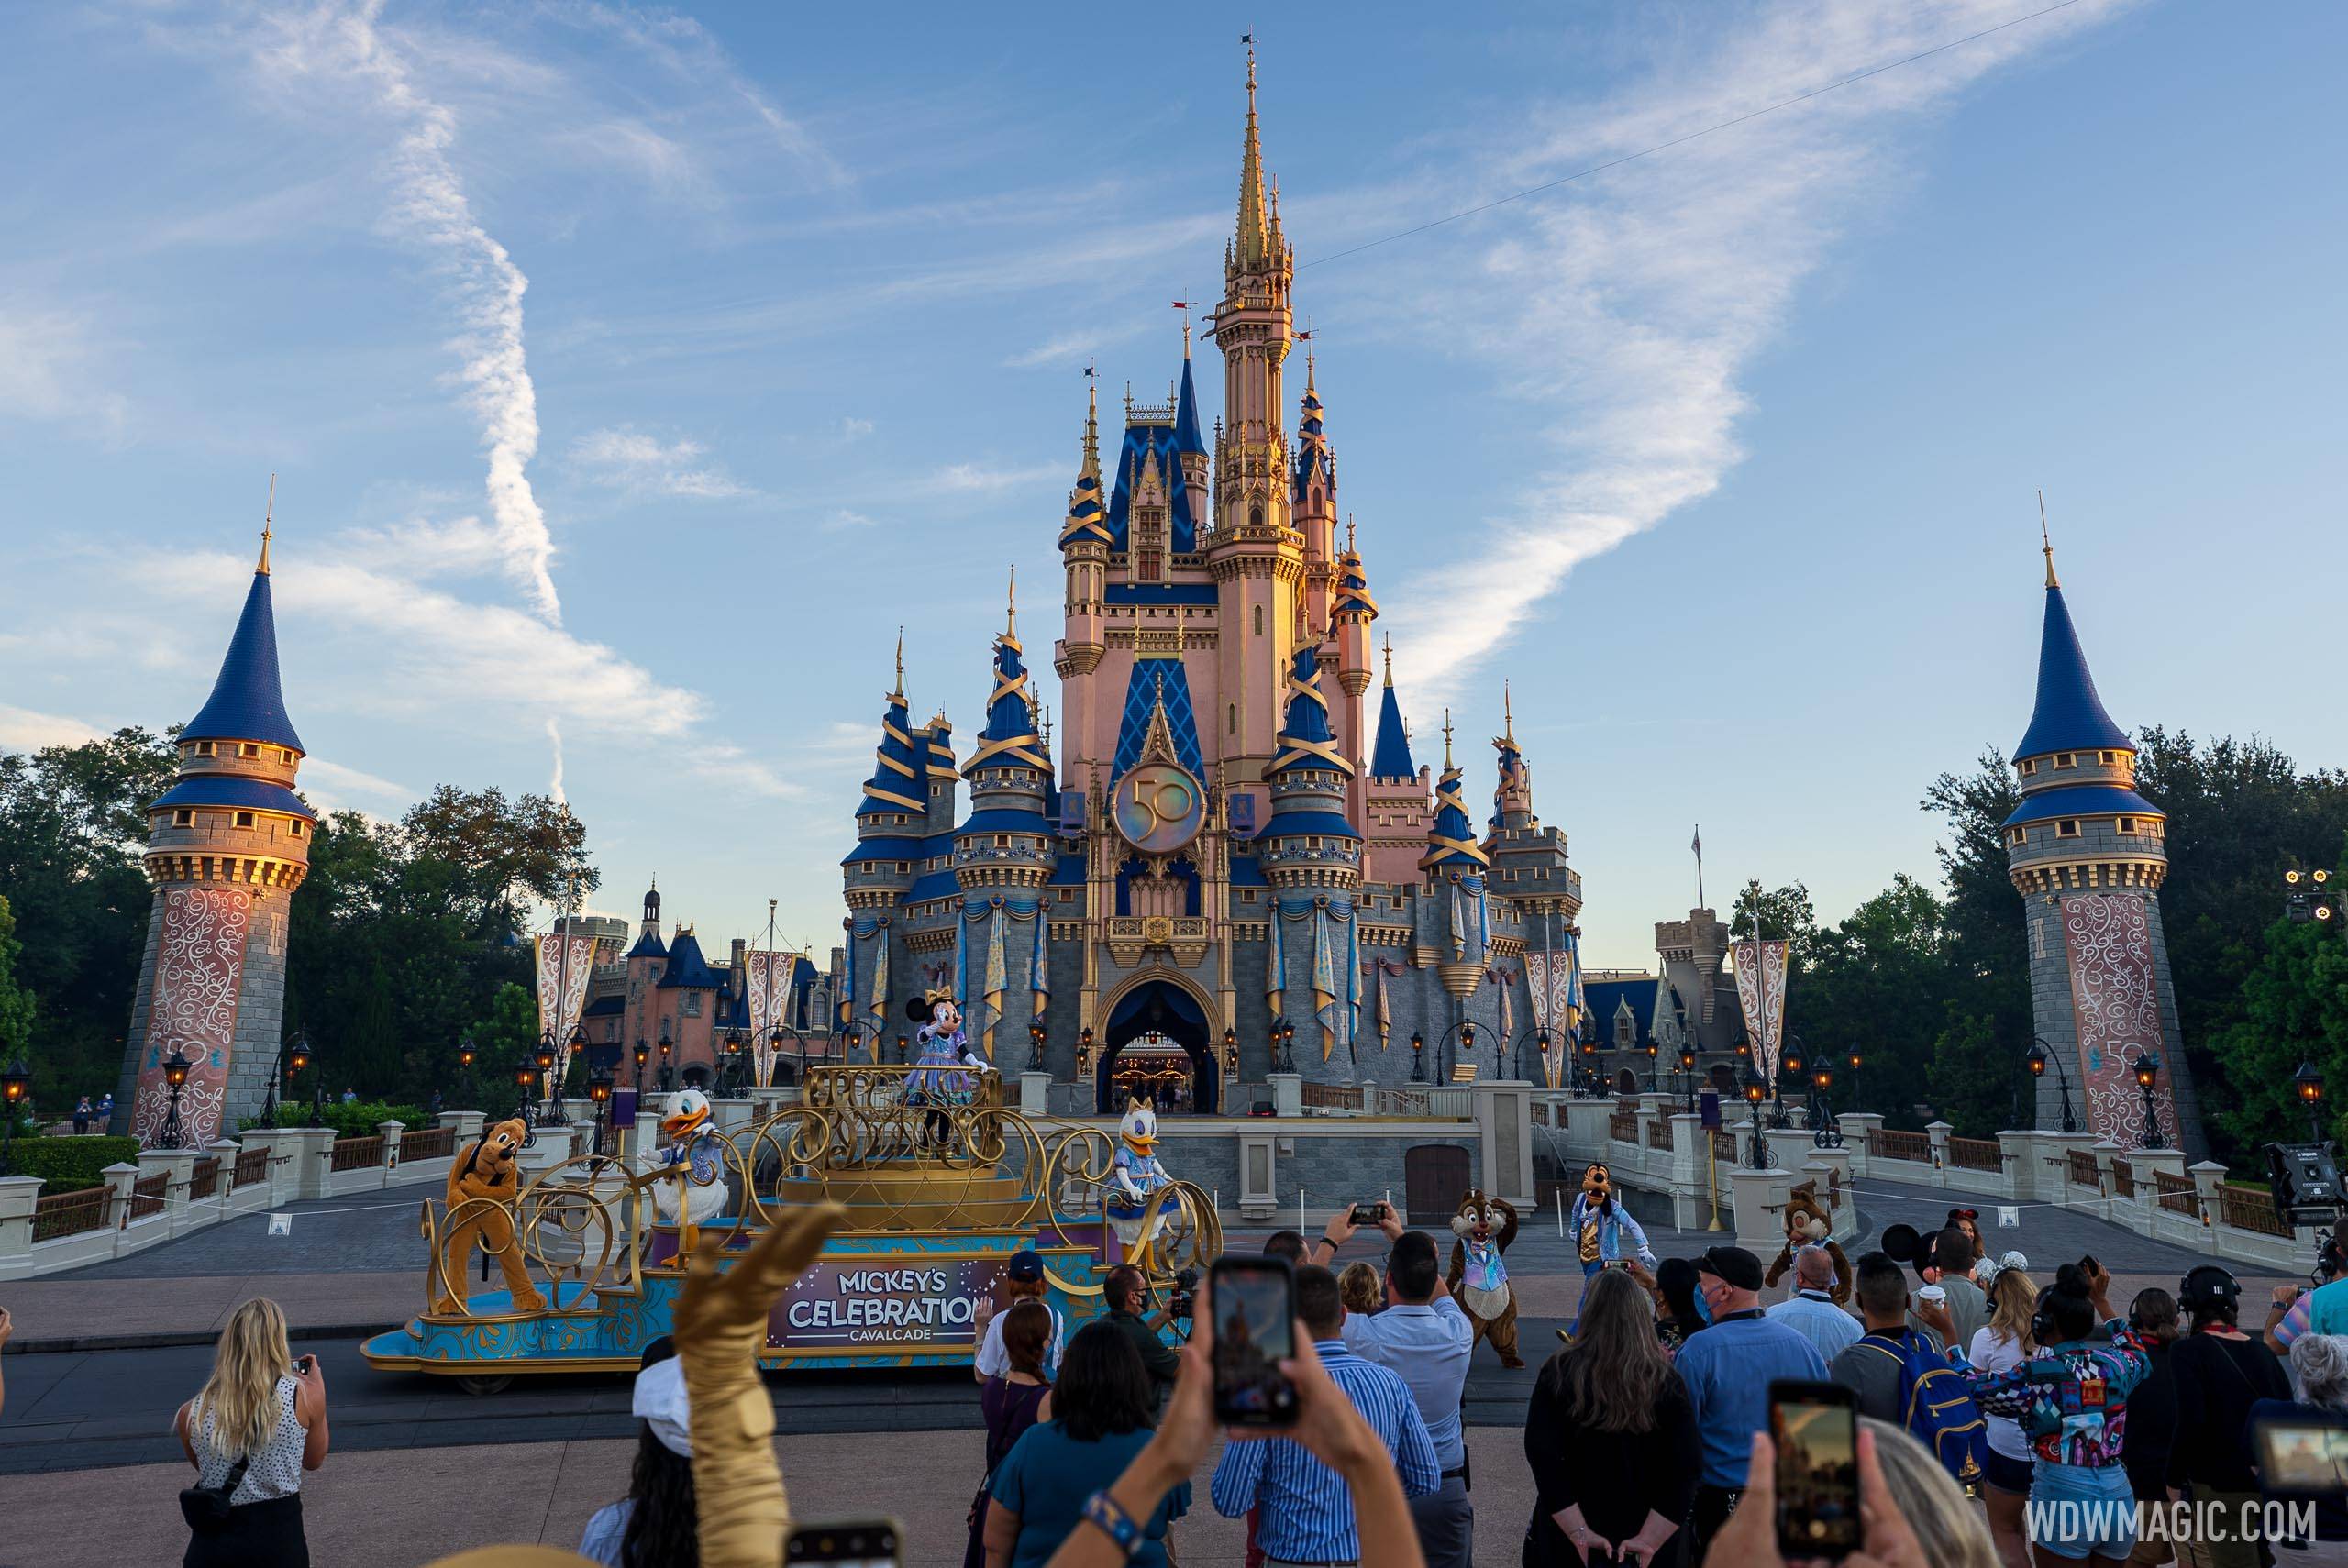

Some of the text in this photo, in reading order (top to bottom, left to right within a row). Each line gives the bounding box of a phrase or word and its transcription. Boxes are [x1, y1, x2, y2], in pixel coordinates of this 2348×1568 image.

[1132, 778, 1193, 843] 50
[2106, 1040, 2148, 1079] 50
[838, 1268, 947, 1294] MICKEY'S
[849, 1329, 931, 1342] CAVALCADE
